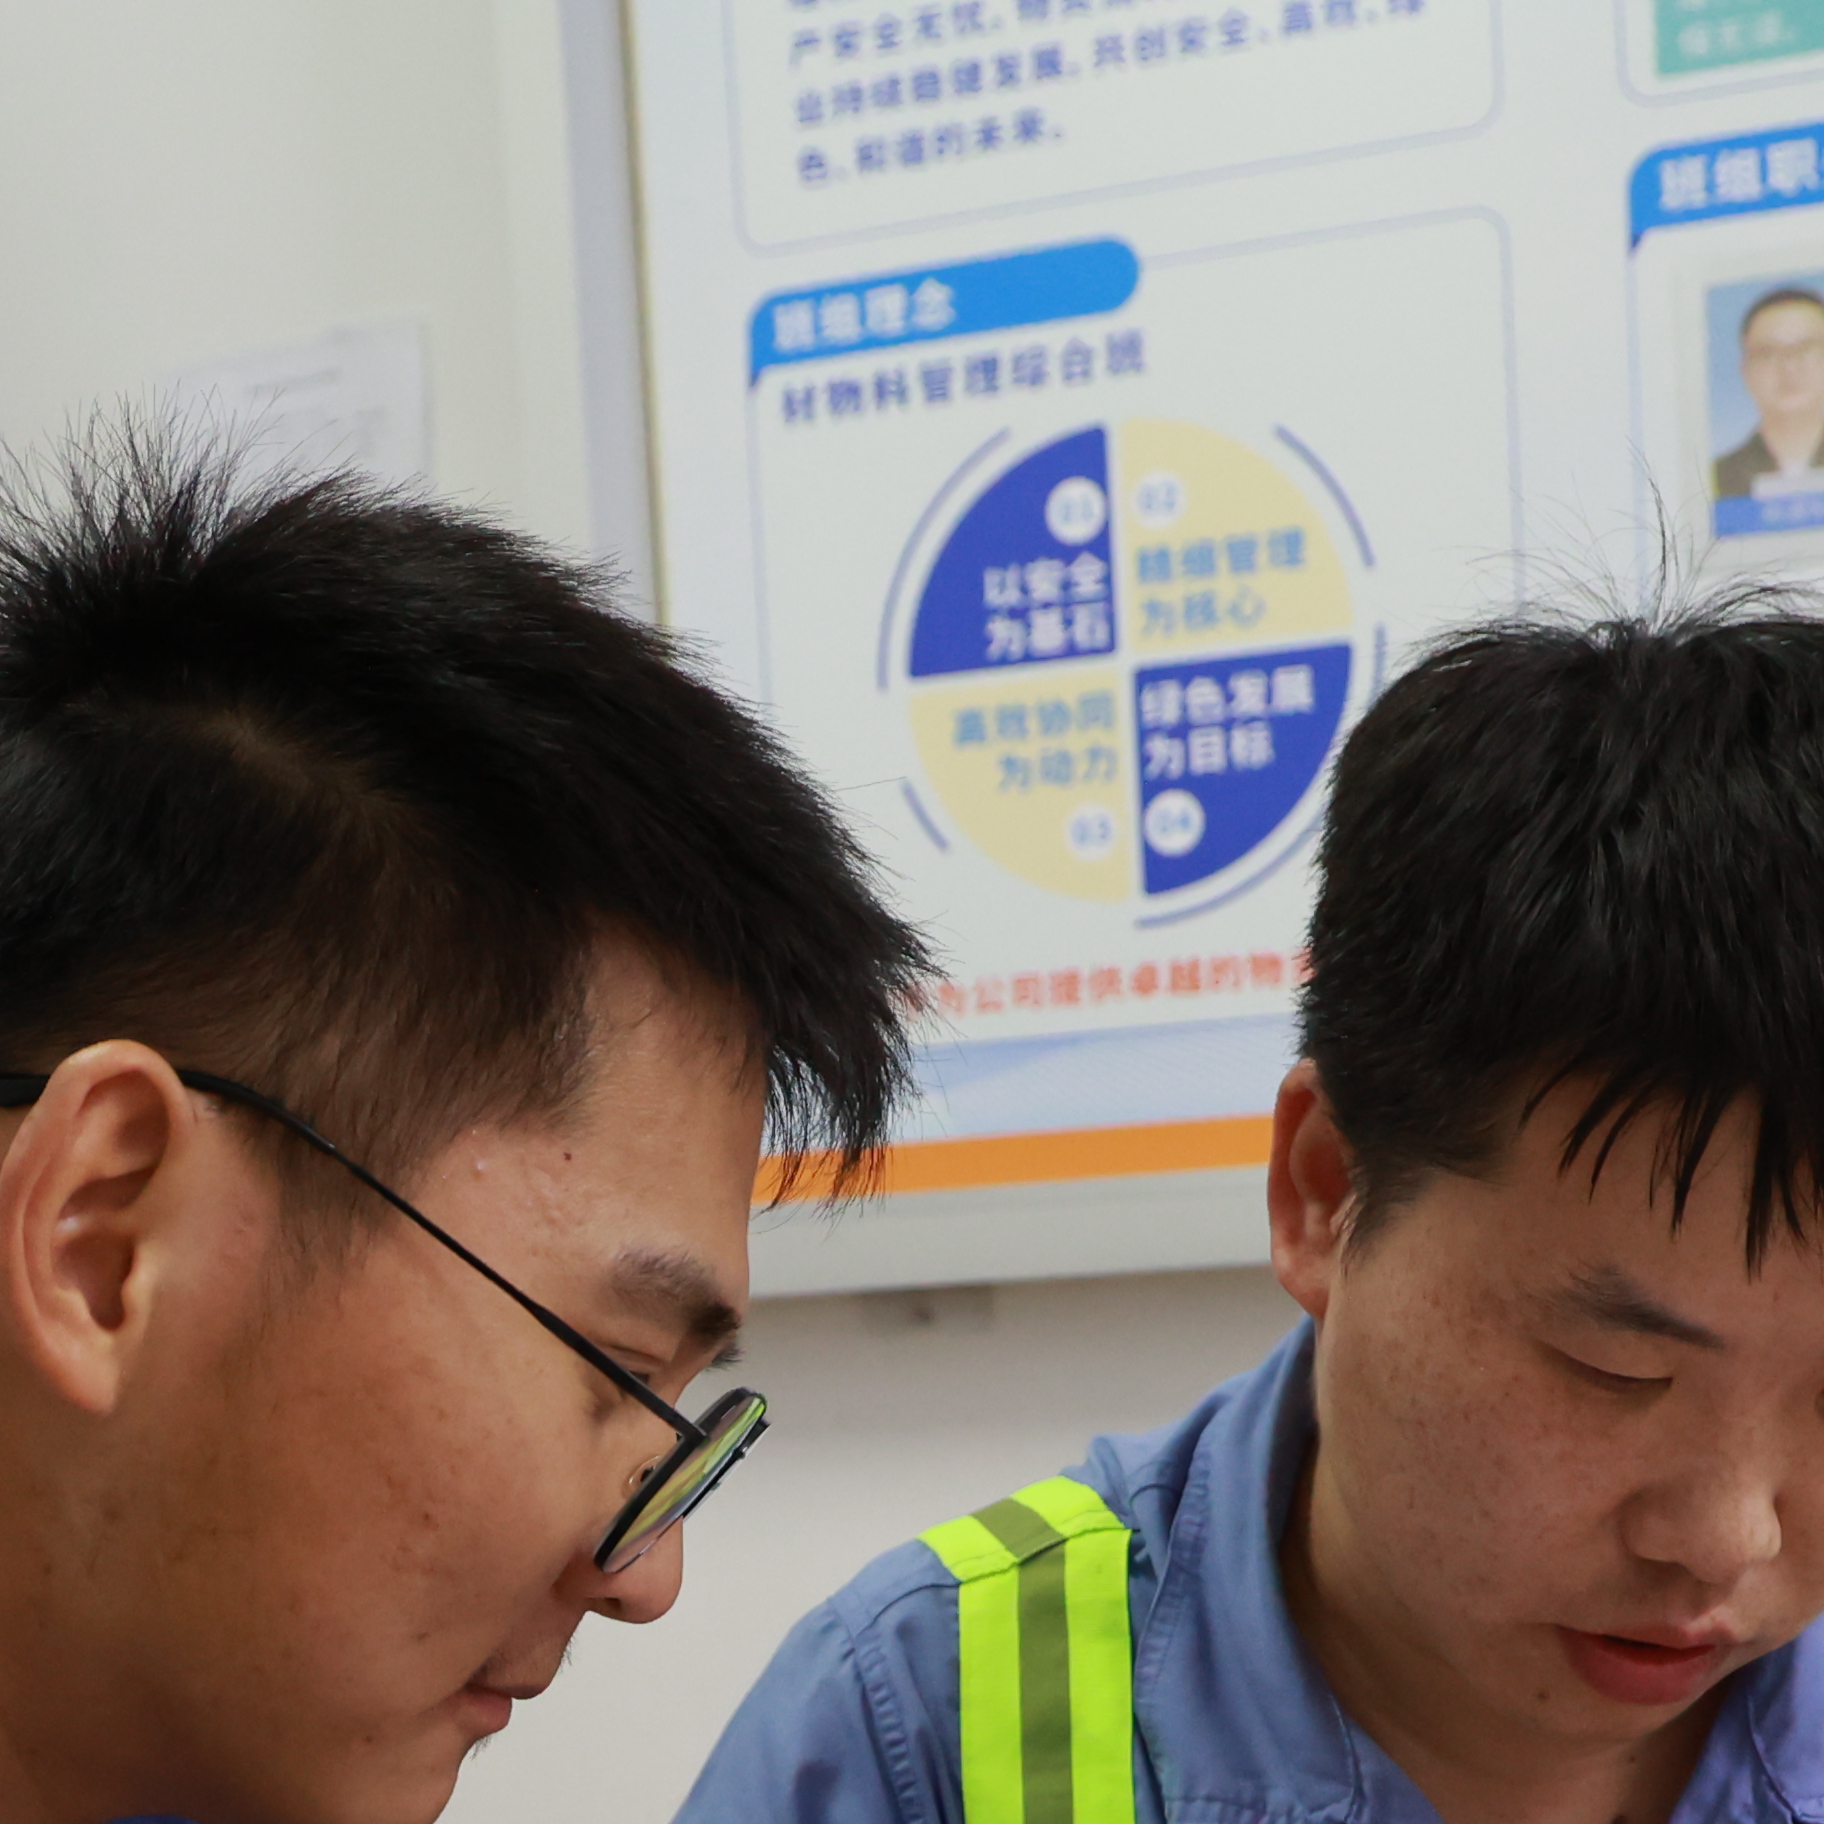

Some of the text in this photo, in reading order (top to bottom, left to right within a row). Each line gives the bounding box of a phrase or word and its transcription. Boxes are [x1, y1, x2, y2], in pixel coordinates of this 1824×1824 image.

[772, 277, 957, 354] 班组理念
[982, 551, 1108, 608] 以安全
[984, 602, 1112, 661] 为基石
[1140, 586, 1267, 638] 为核心
[1139, 664, 1316, 729] 绿色发展
[998, 744, 1118, 794] 为动力
[1144, 720, 1276, 780] 为目标
